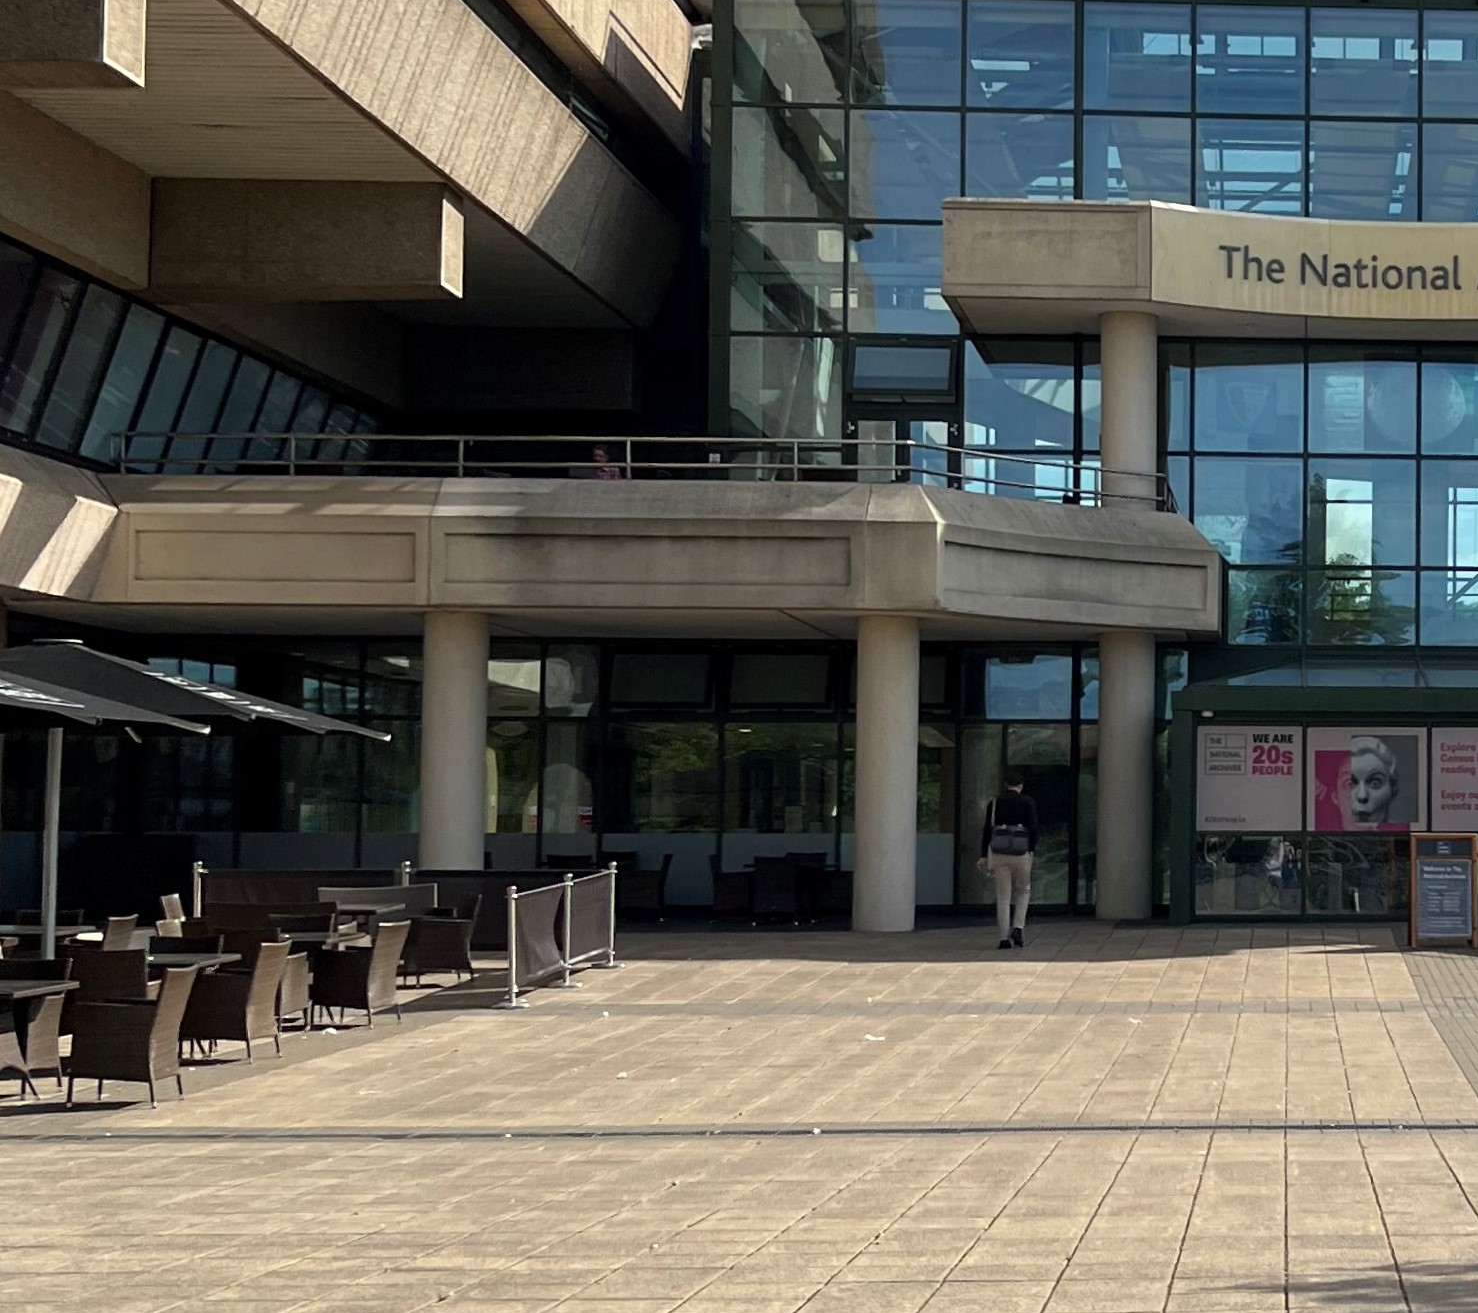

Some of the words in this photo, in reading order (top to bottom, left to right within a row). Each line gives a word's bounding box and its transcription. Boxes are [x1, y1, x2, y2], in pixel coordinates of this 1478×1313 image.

[1219, 245, 1285, 284] The
[1300, 252, 1462, 290] National
[1252, 733, 1270, 743] WE
[1272, 733, 1294, 744] ARE
[1440, 742, 1476, 753] Explore
[1252, 745, 1294, 765] 20s
[1440, 753, 1475, 763] Census
[1251, 765, 1294, 776] PEOPLE
[1440, 765, 1477, 776] reading
[1440, 790, 1467, 801] Enjoy
[1440, 803, 1472, 811] events
